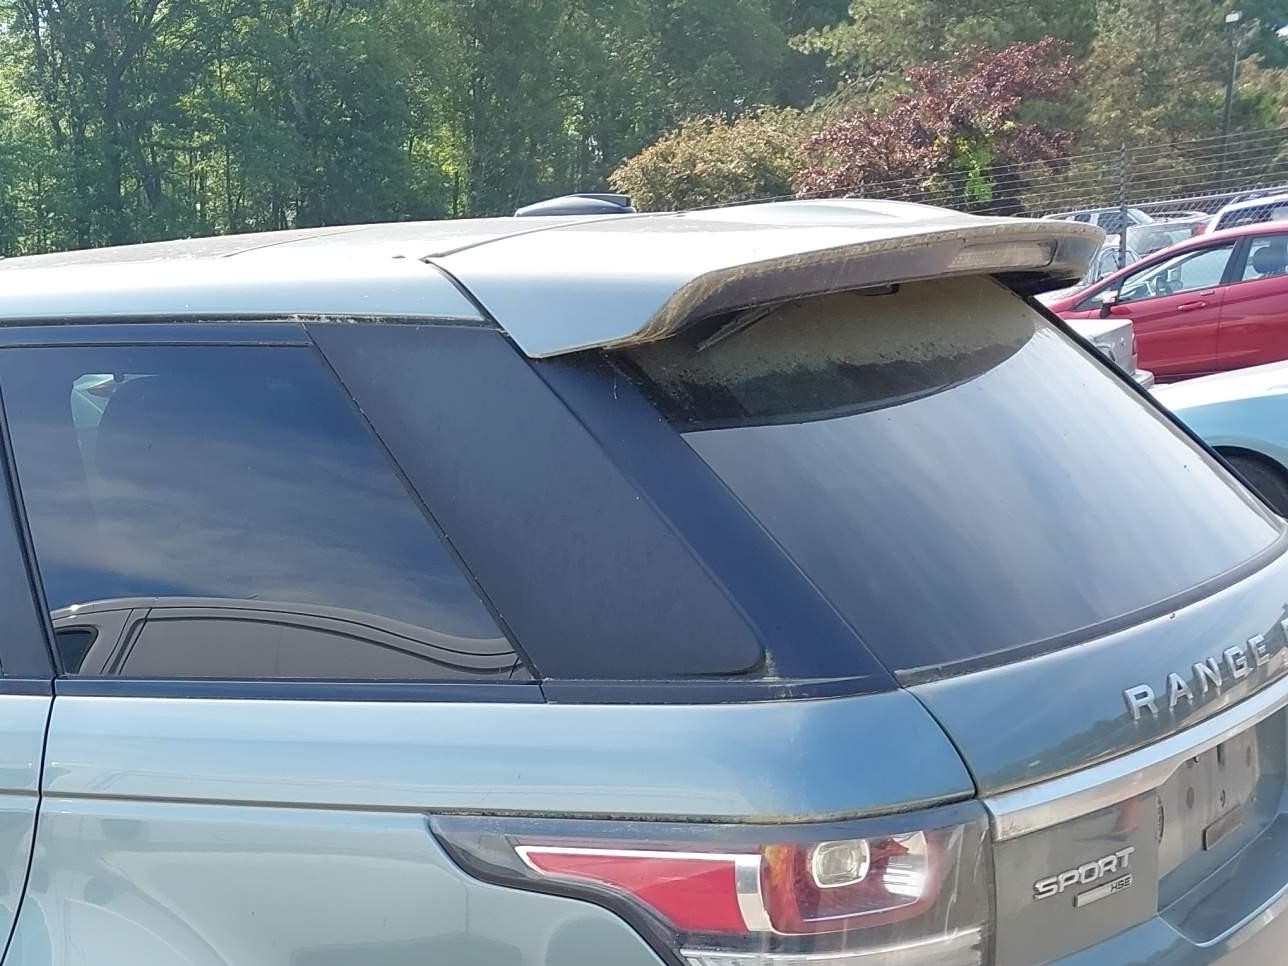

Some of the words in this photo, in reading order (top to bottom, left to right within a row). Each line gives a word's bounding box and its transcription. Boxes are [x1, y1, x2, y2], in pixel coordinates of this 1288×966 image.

[1122, 633, 1272, 720] RANGE
[1032, 845, 1136, 900] SPORT
[1109, 876, 1132, 893] HSE
